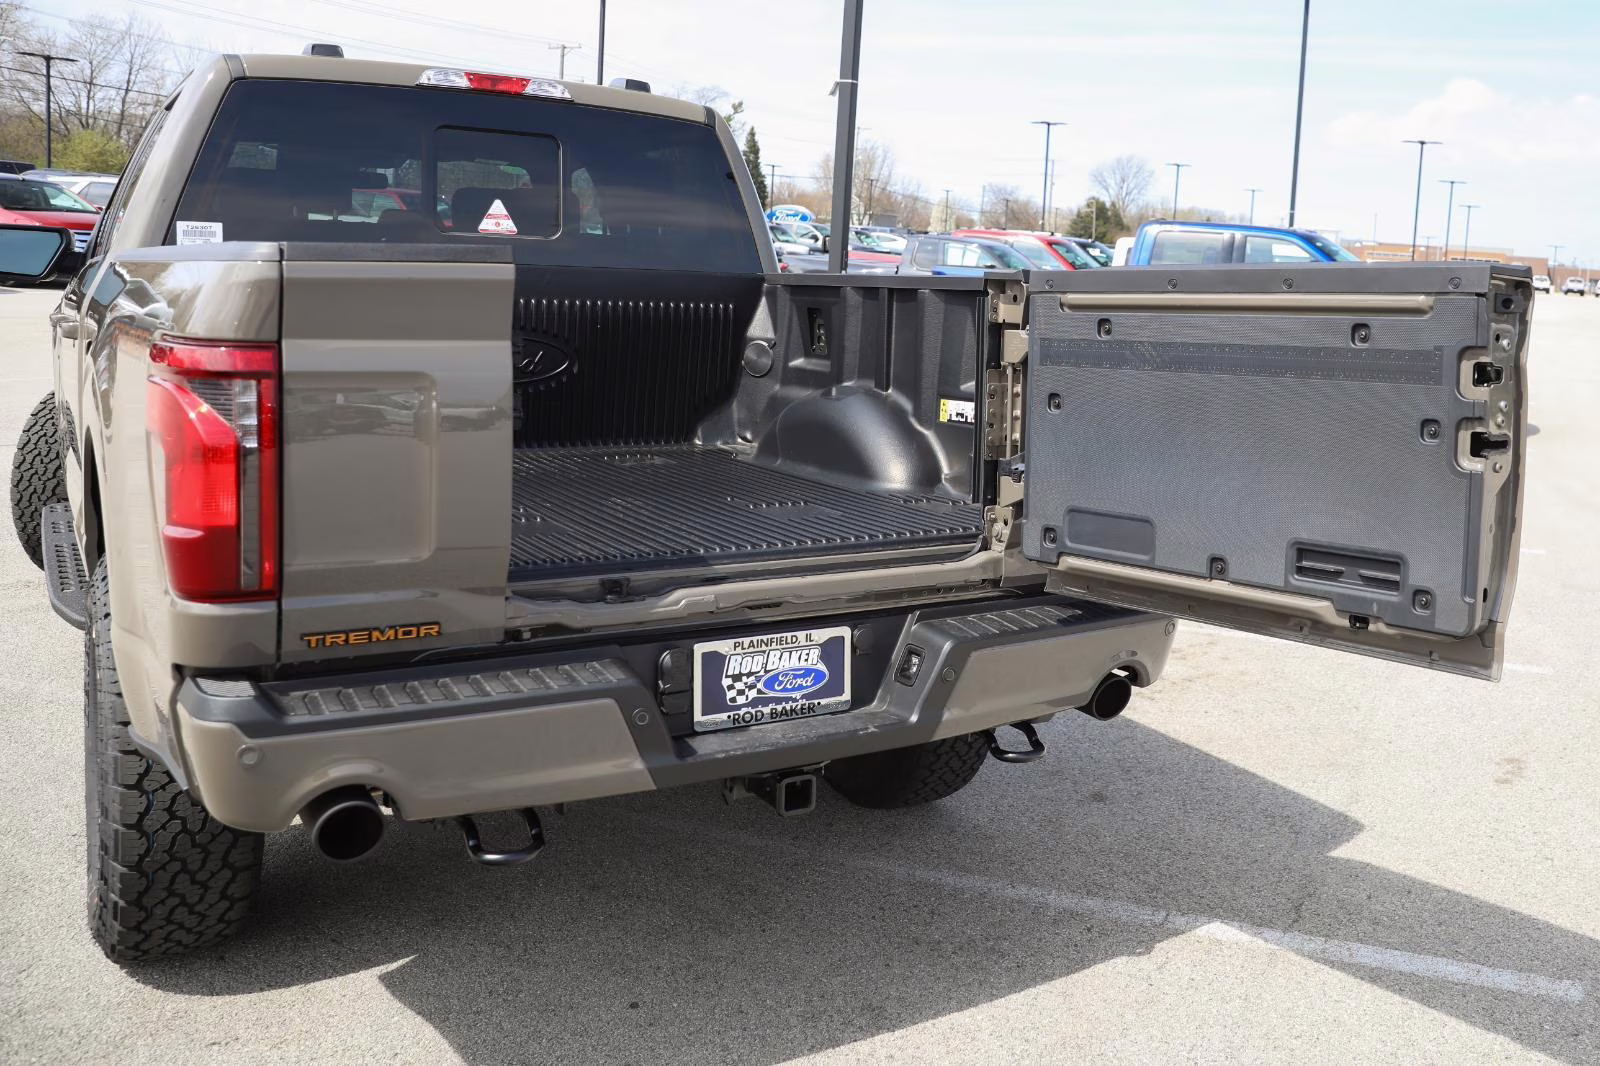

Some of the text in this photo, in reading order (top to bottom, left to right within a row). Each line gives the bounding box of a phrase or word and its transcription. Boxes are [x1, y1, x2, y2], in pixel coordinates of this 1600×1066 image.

[302, 621, 441, 649] TREMOR
[733, 632, 815, 651] PLAINFIELD, IL
[726, 648, 820, 676] ROD BAKER
[774, 669, 815, 690] Ford
[732, 709, 765, 726] ROD
[770, 702, 817, 720] BAKER
